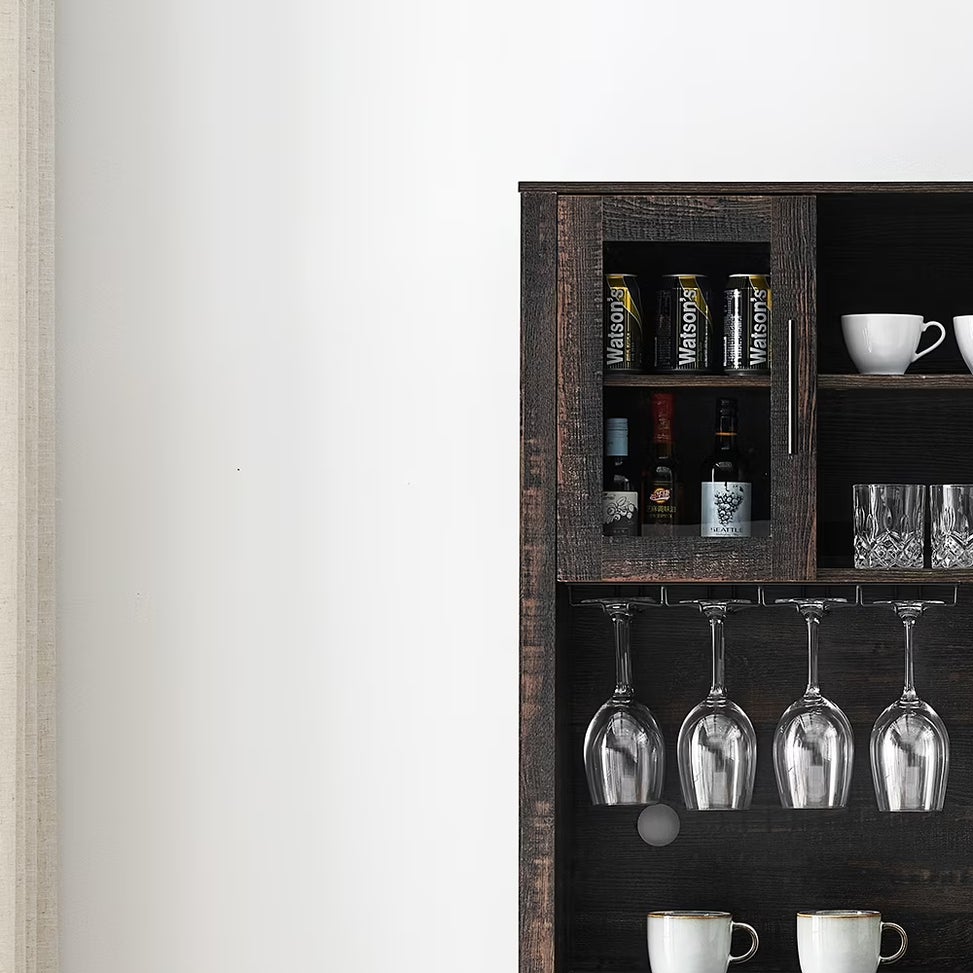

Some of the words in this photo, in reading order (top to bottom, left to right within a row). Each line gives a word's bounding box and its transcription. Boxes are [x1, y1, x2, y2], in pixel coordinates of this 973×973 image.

[606, 288, 624, 365] Watson's
[678, 288, 697, 366] Watson's
[749, 289, 767, 366] Watson's
